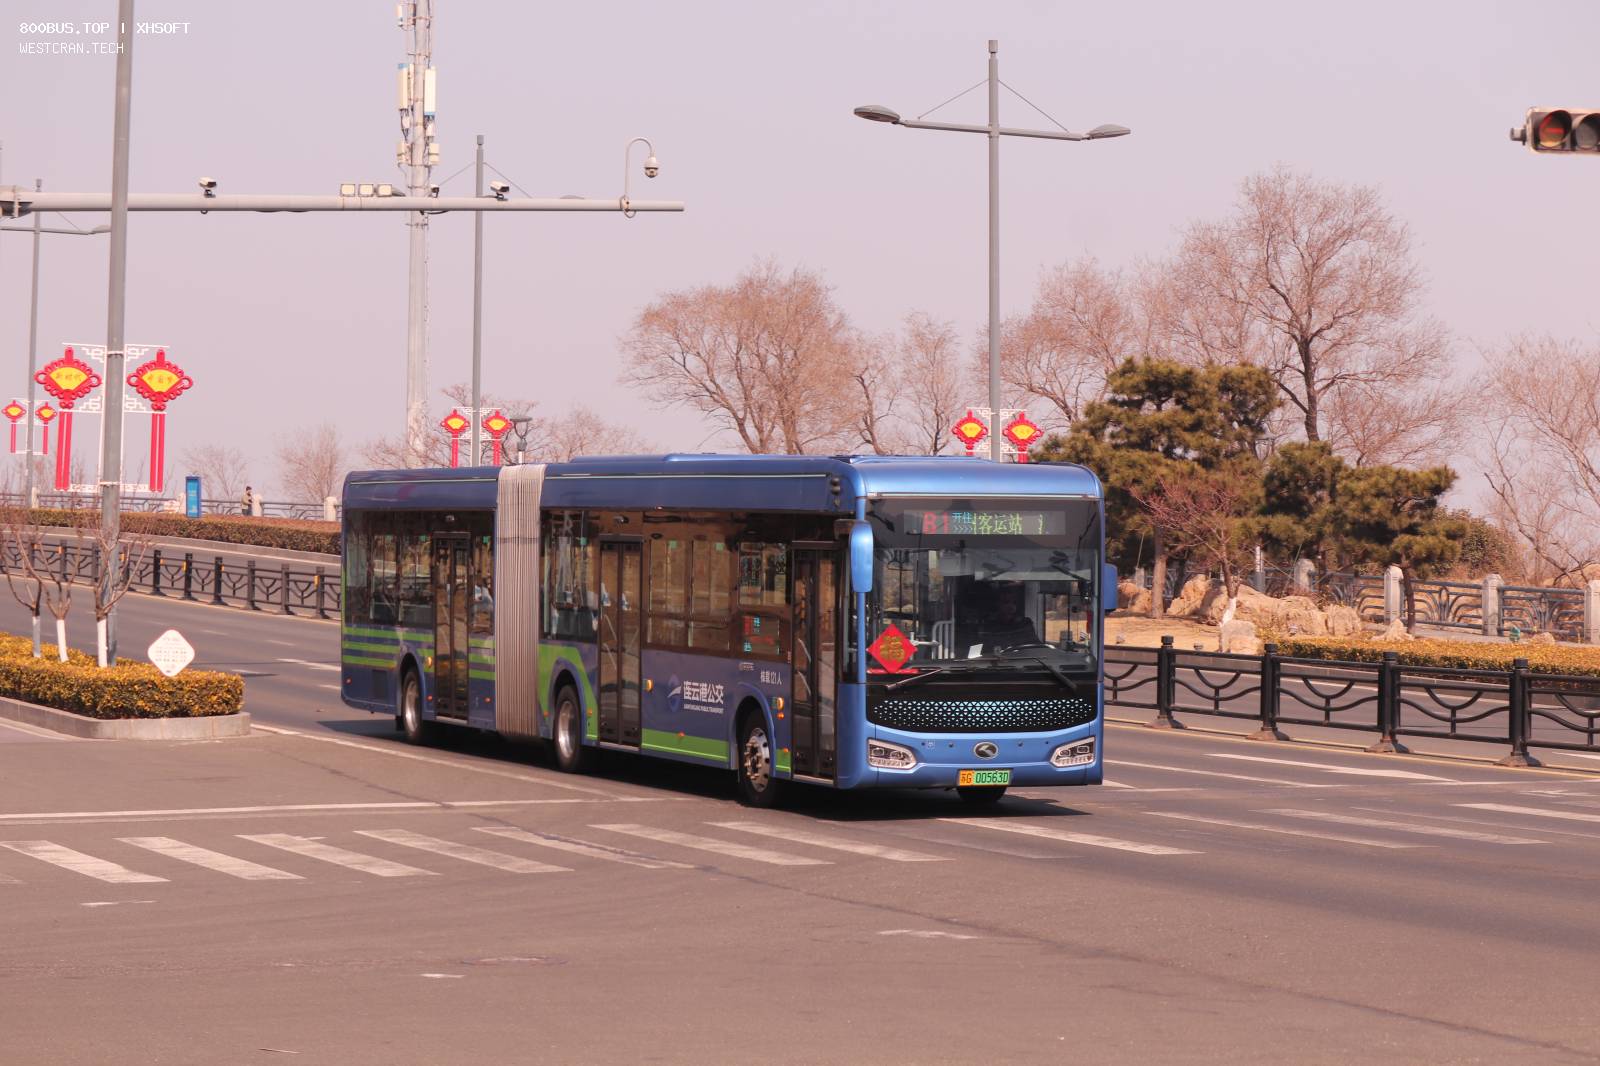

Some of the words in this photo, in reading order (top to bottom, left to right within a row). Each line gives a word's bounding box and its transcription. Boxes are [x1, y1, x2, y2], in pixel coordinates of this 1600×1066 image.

[923, 511, 948, 534] B1
[683, 680, 724, 704] 连云港公交
